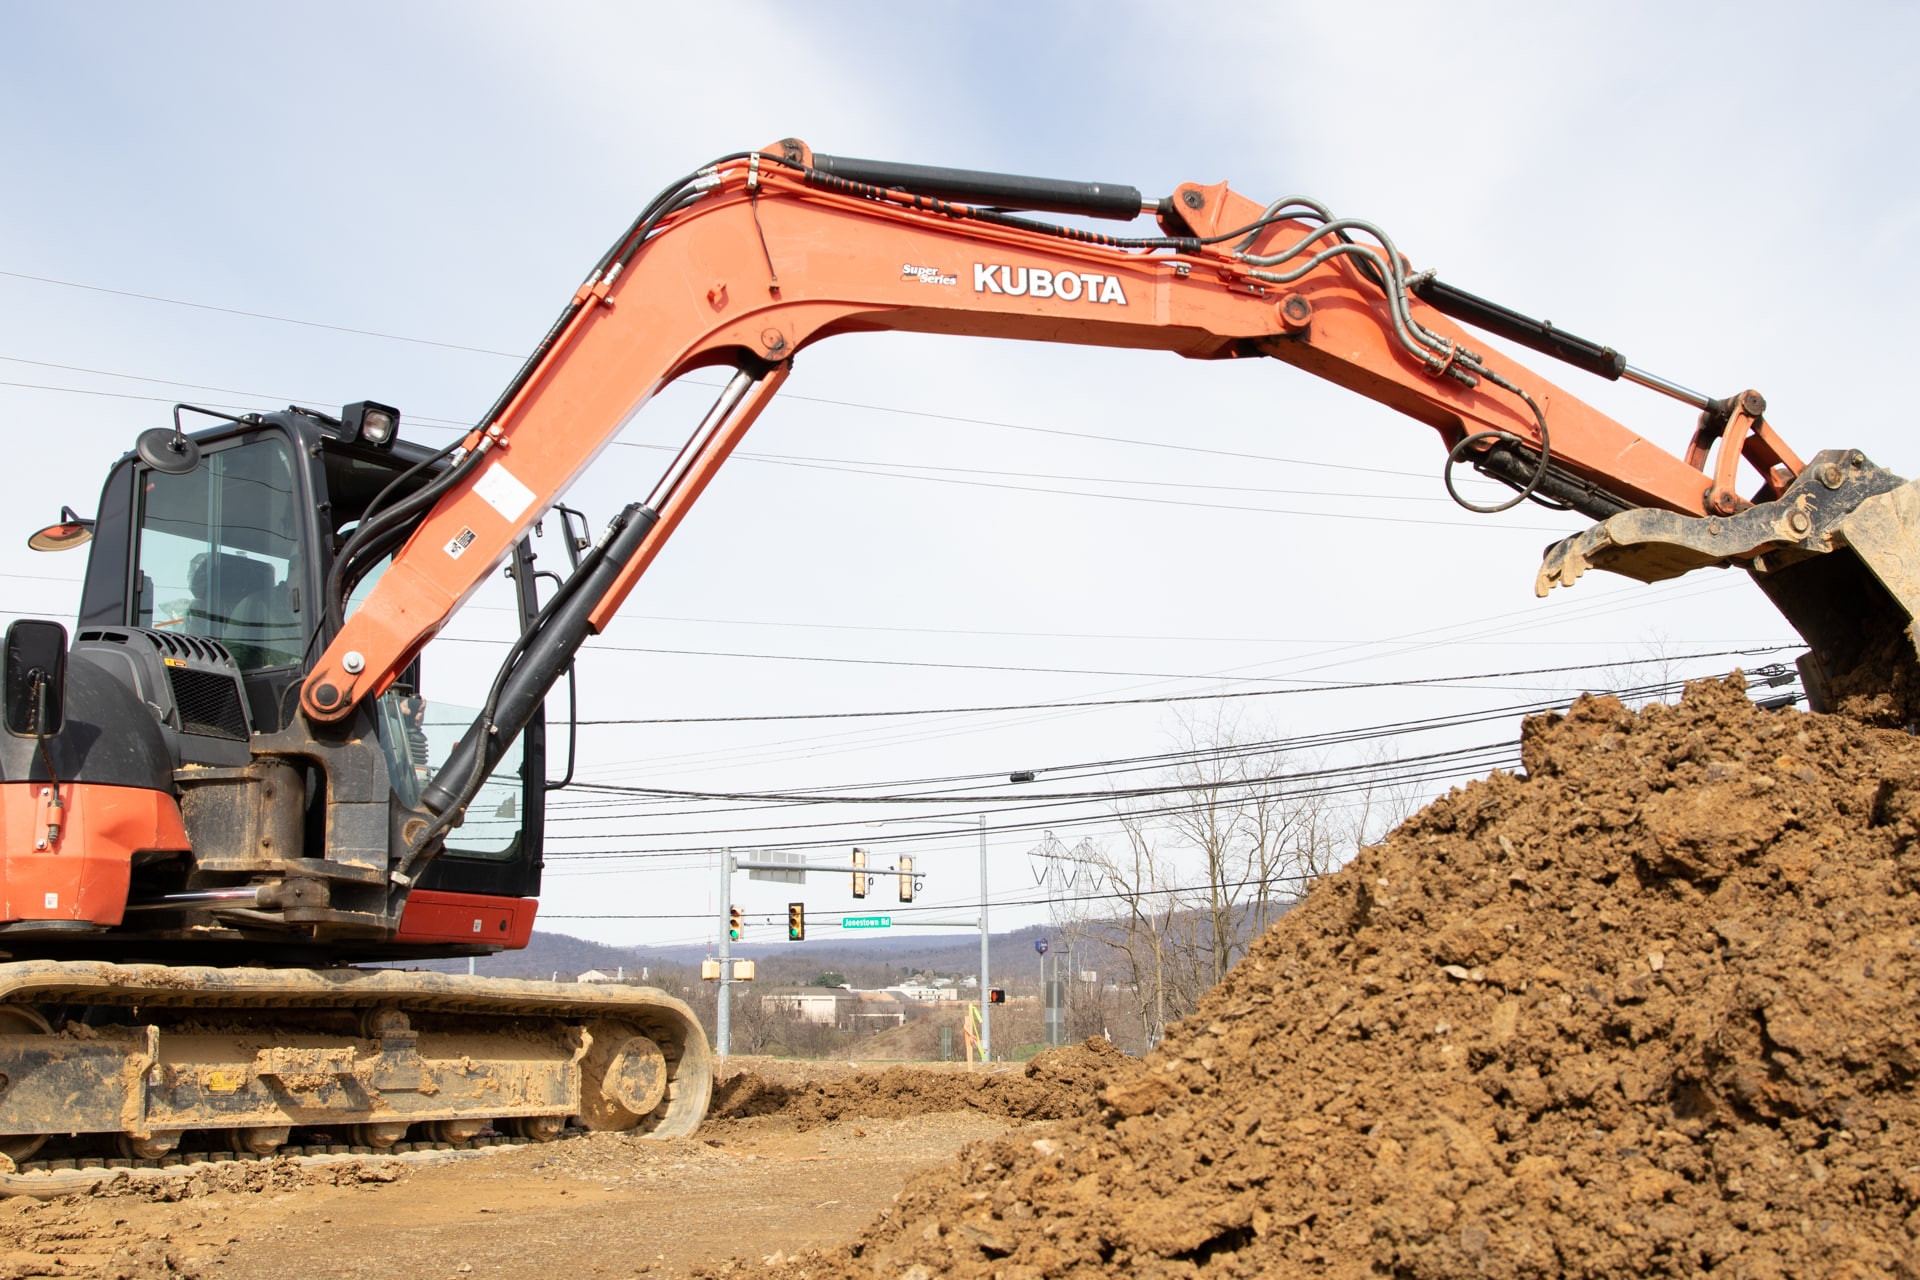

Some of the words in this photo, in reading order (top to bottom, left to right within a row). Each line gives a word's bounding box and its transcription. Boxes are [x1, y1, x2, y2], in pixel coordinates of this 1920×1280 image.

[903, 264, 939, 276] Super
[920, 275, 957, 285] Series
[973, 263, 1128, 305] KUBOTA
